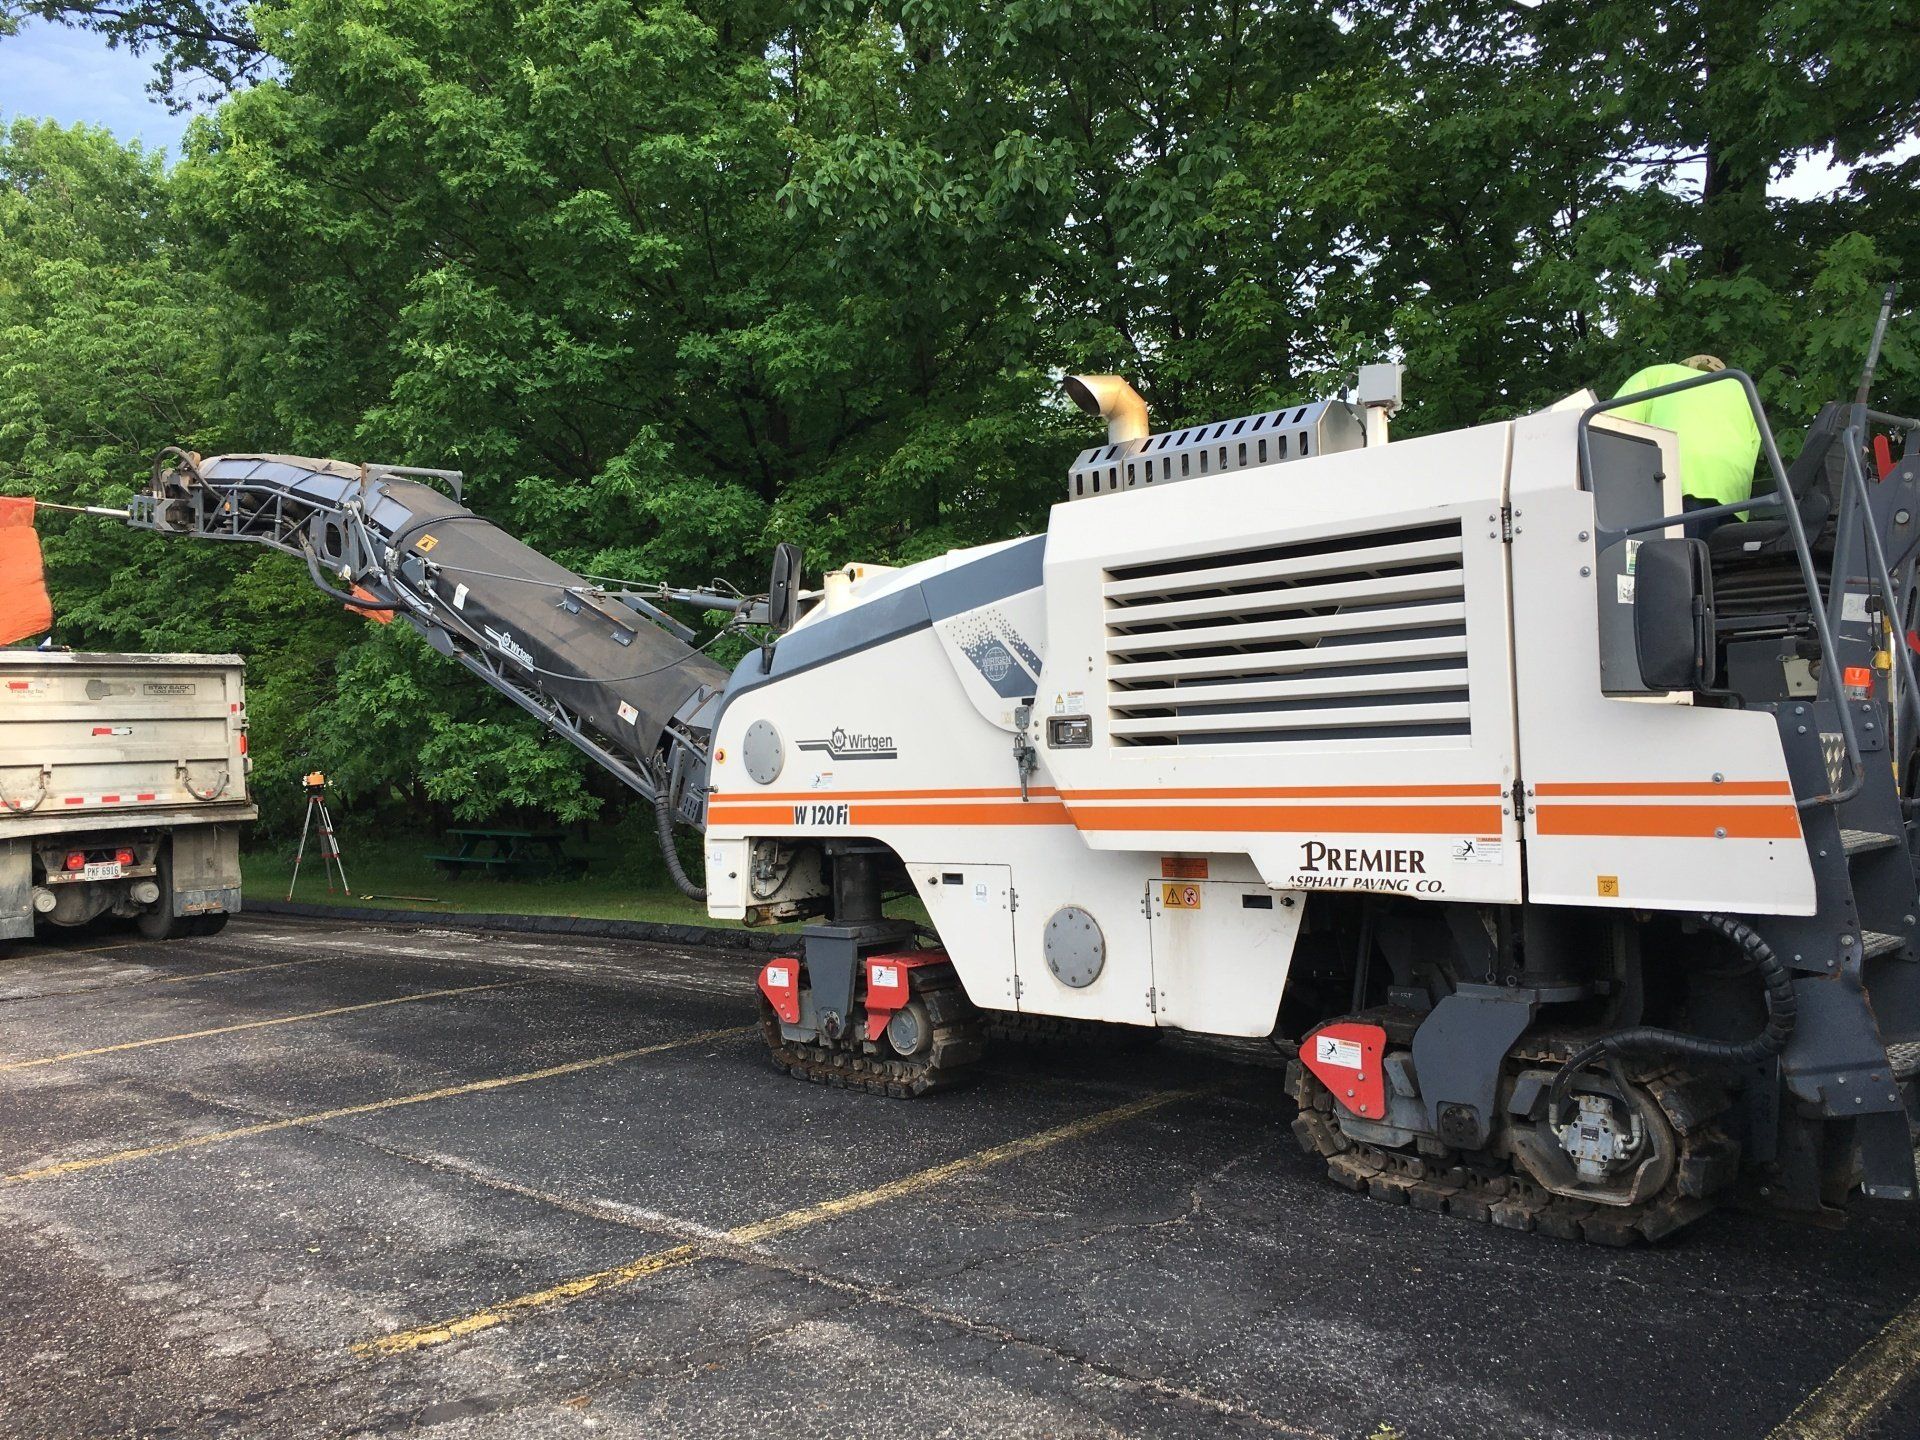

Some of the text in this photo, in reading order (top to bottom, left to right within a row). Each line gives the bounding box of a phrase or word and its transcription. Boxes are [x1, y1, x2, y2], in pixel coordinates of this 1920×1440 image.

[982, 655, 1011, 667] WIRTGEN
[848, 734, 893, 751] Wirtgen
[794, 804, 848, 826] W 120 Fi
[1299, 840, 1426, 873] PREMIER
[101, 865, 119, 876] 6916
[1353, 877, 1409, 891] PAVING
[1415, 879, 1445, 893] CO.
